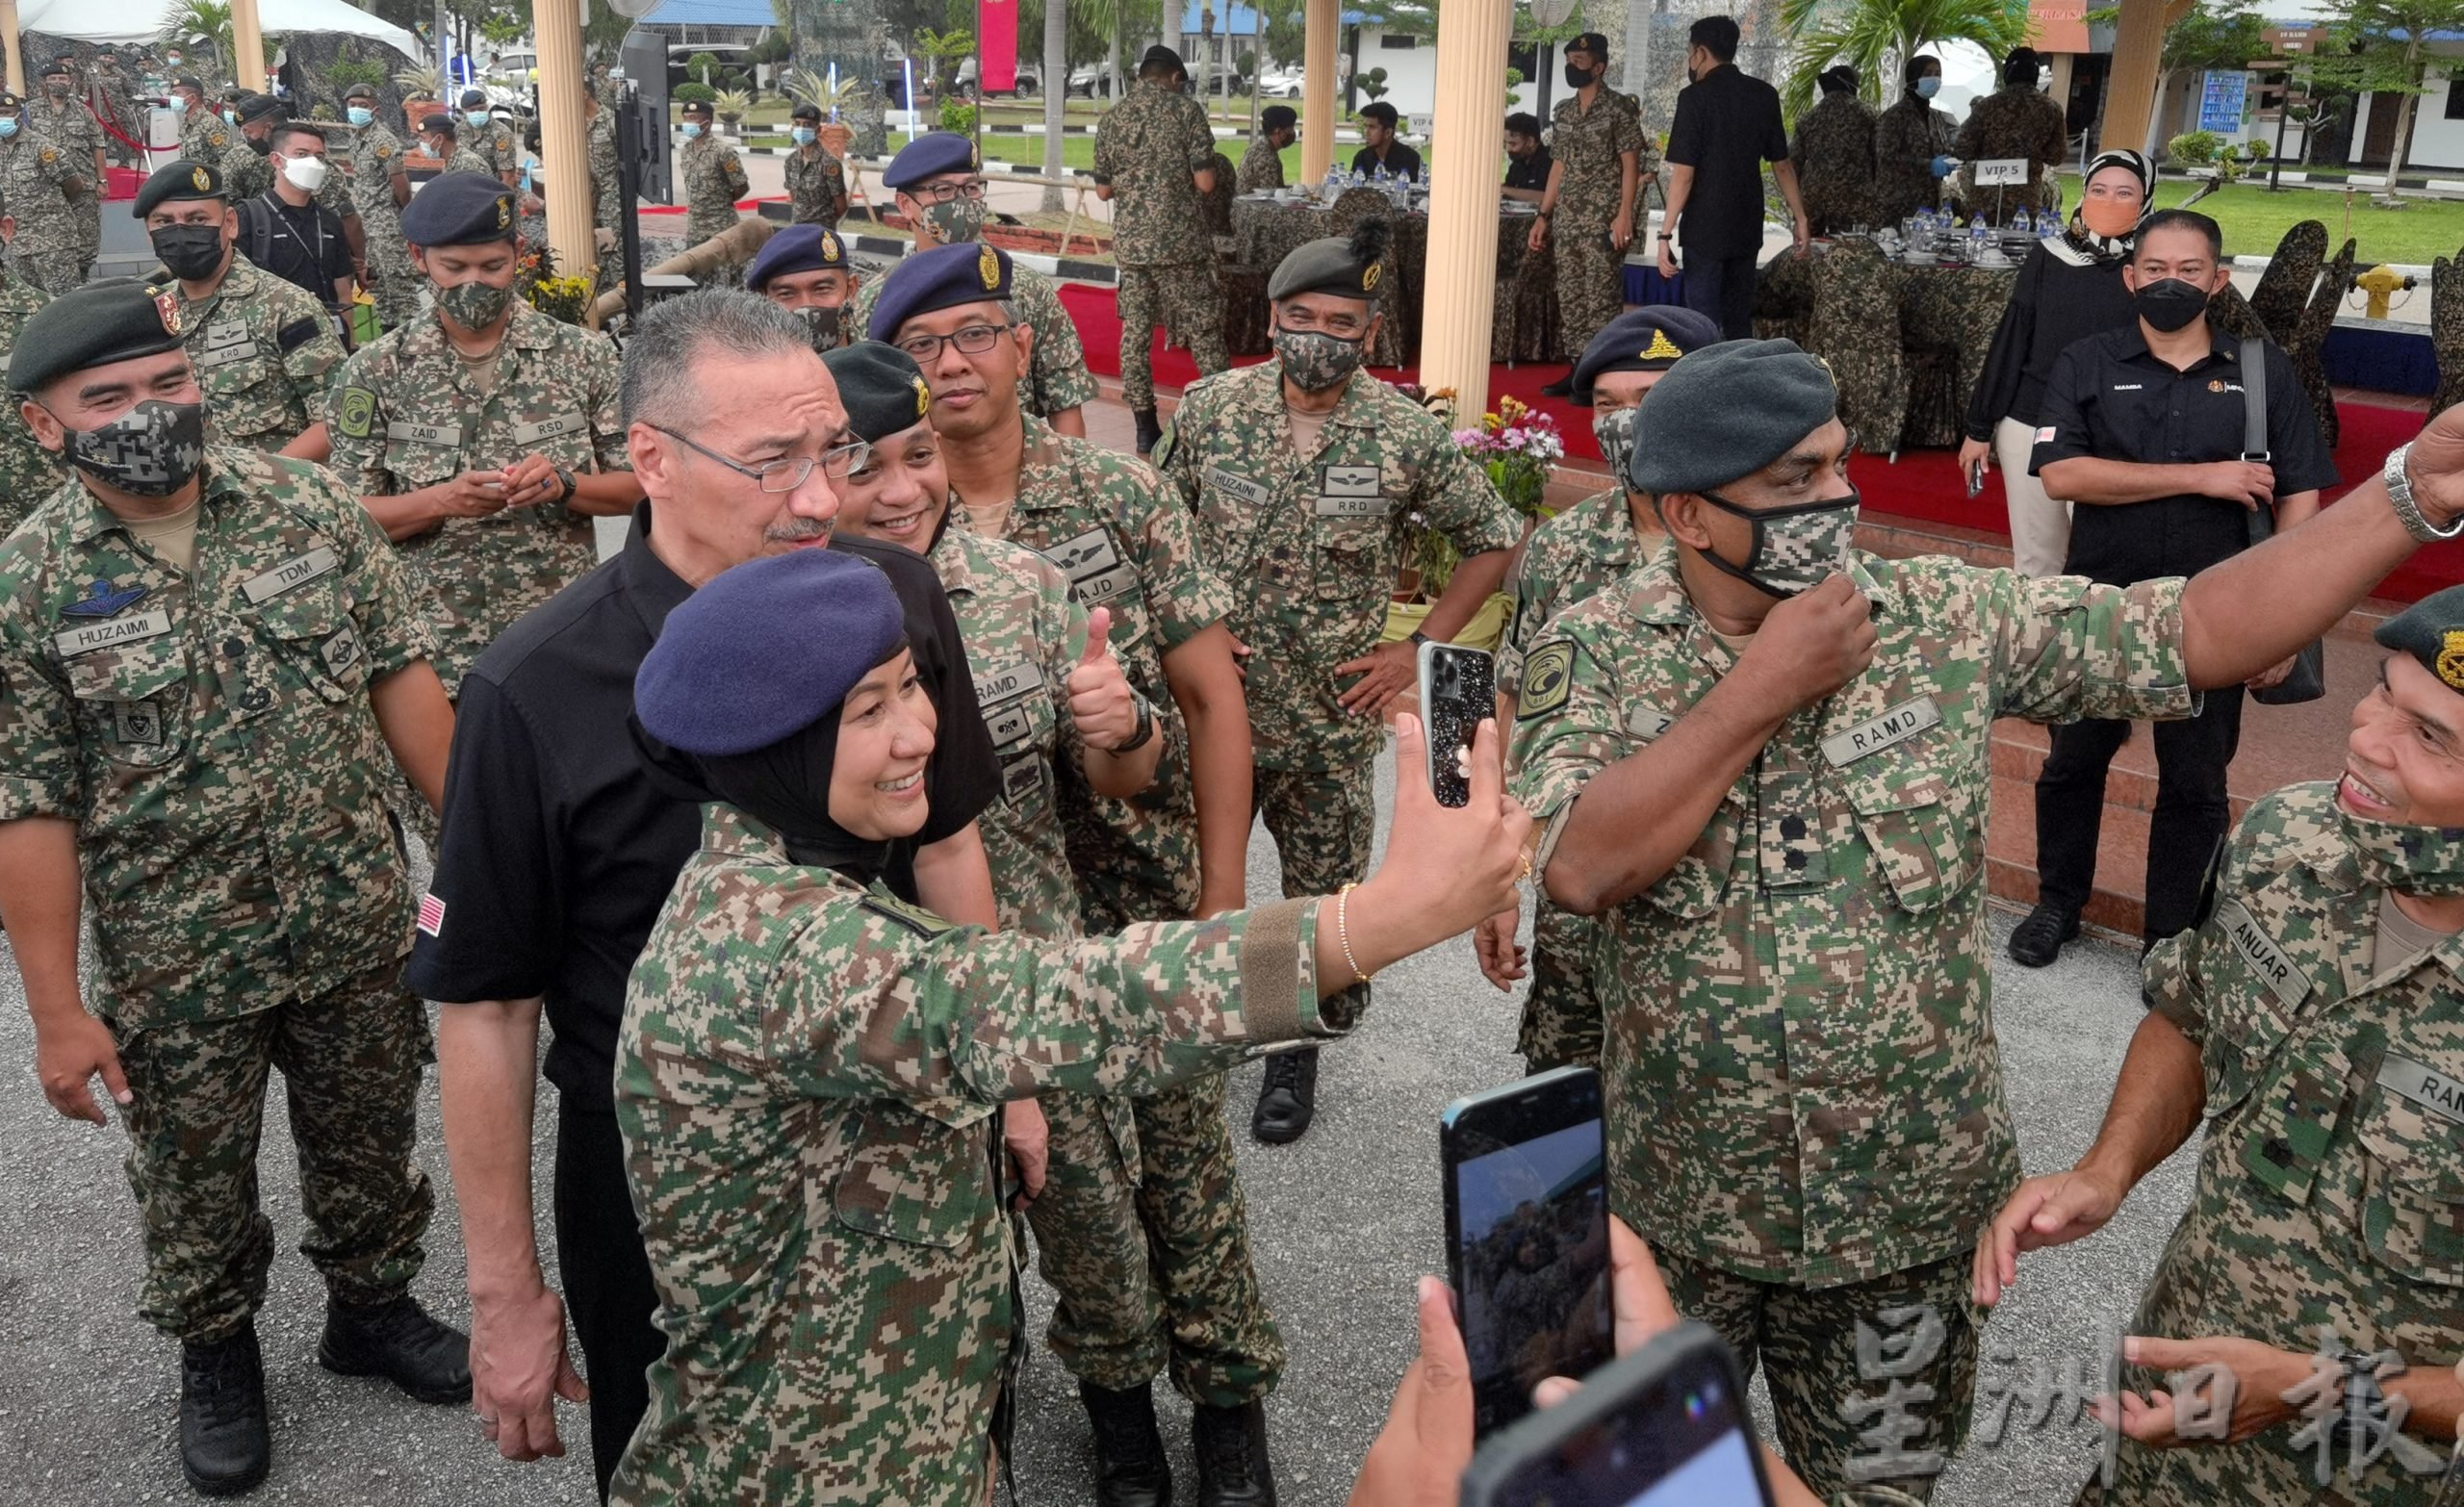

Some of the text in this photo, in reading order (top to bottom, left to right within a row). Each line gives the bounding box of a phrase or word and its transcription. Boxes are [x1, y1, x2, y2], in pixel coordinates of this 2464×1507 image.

[1413, 117, 1426, 126] VIP
[1985, 165, 2019, 175] VIP 5
[220, 347, 239, 359] KRD
[411, 426, 438, 440] ZAID
[538, 421, 564, 435] RSD
[1215, 473, 1256, 498] HUZAINI
[1338, 501, 1368, 512] RRD
[275, 560, 314, 584] TDM
[78, 619, 150, 646] HUZAIMI
[976, 675, 1018, 702] RAMD
[1852, 710, 1917, 751] RAMD
[2234, 922, 2289, 984] ANUAR
